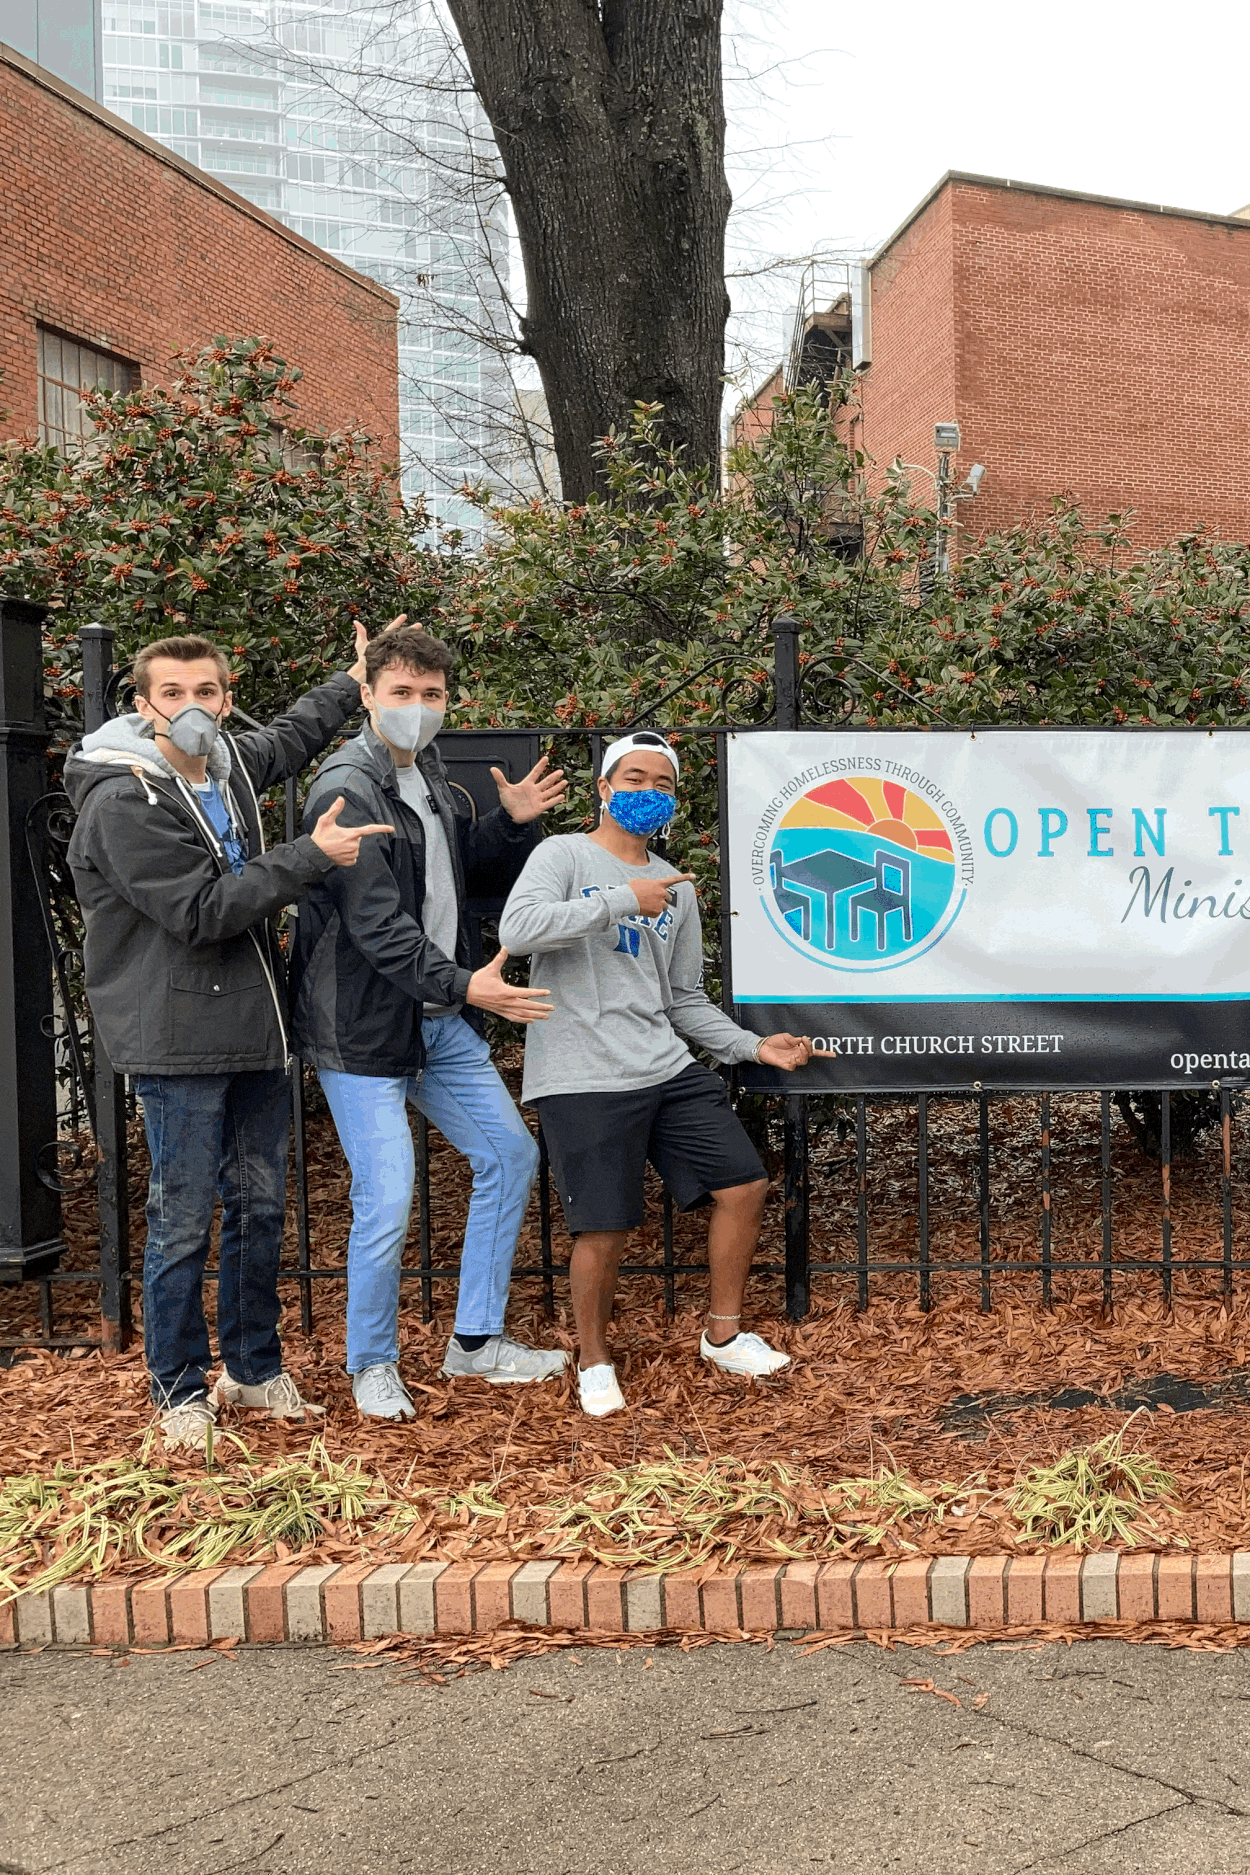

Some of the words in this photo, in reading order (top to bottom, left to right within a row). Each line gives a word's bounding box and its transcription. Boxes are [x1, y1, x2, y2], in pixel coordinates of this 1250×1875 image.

[752, 797, 784, 885] OVERCOMING
[780, 756, 881, 800] HOMELESSNESS
[885, 760, 945, 802] THROUGH
[941, 801, 974, 884] COMMUNITY
[984, 807, 1168, 857] OPEN
[808, 1035, 874, 1055] ORTH
[880, 1035, 975, 1055] CHURCH
[981, 1034, 1064, 1054] STREET
